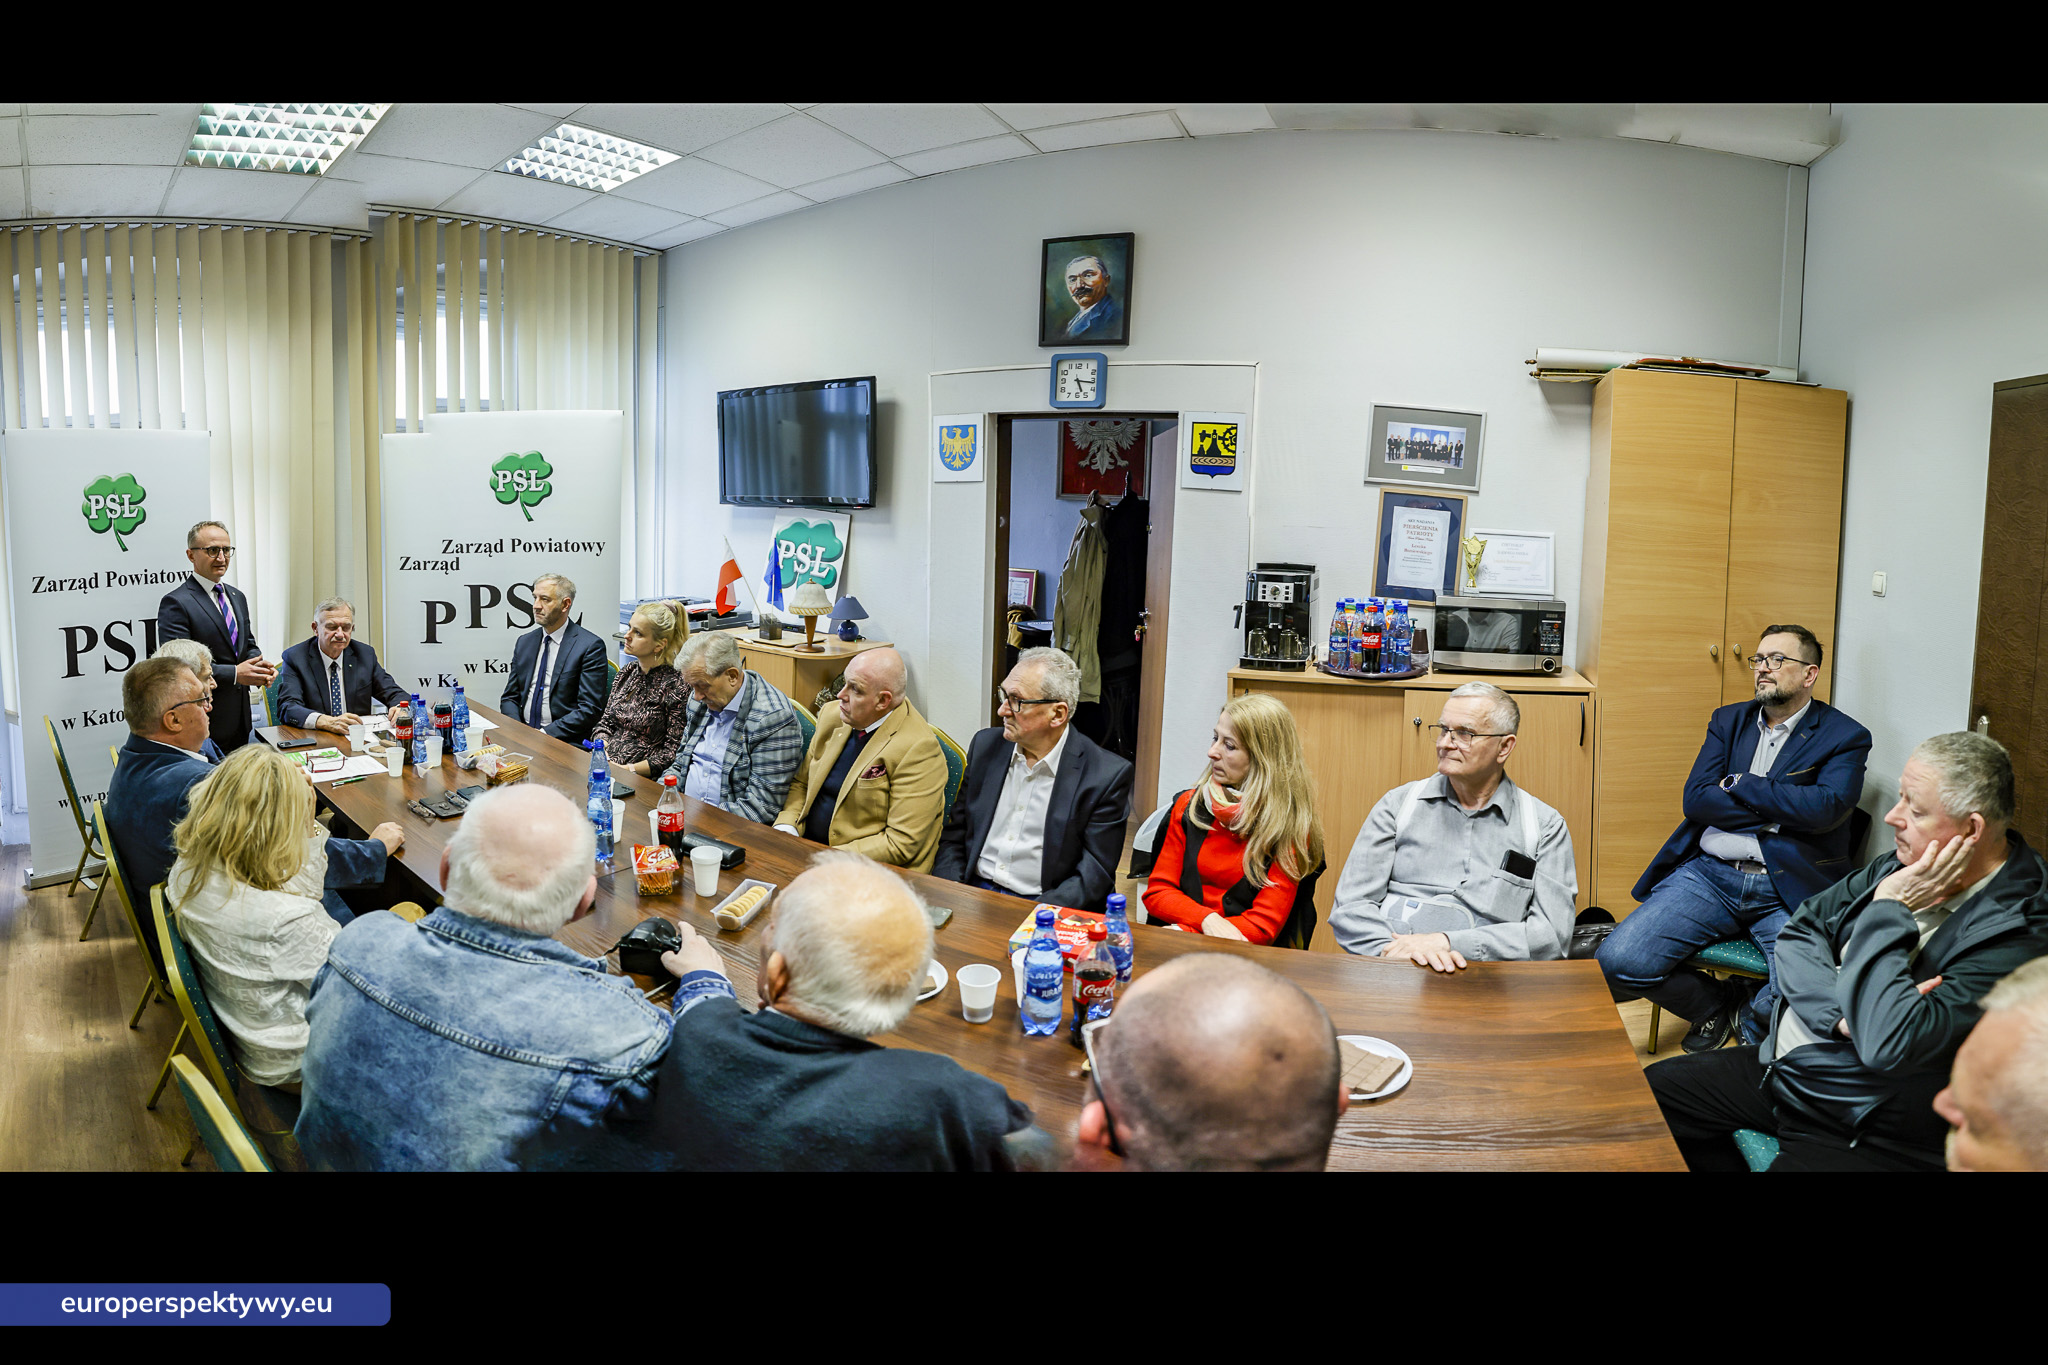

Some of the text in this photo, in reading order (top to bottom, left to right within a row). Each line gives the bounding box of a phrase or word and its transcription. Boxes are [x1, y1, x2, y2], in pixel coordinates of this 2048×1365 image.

[496, 469, 546, 493] PSL
[88, 493, 140, 520] PSL
[441, 537, 606, 558] Zarząd Powiatowy
[779, 539, 830, 579] PSL
[399, 555, 460, 575] Zarząd
[32, 568, 194, 595] Zarząd Powiatow
[420, 600, 457, 644] P
[464, 663, 478, 674] w
[418, 677, 432, 688] w
[61, 708, 125, 731] w Kato
